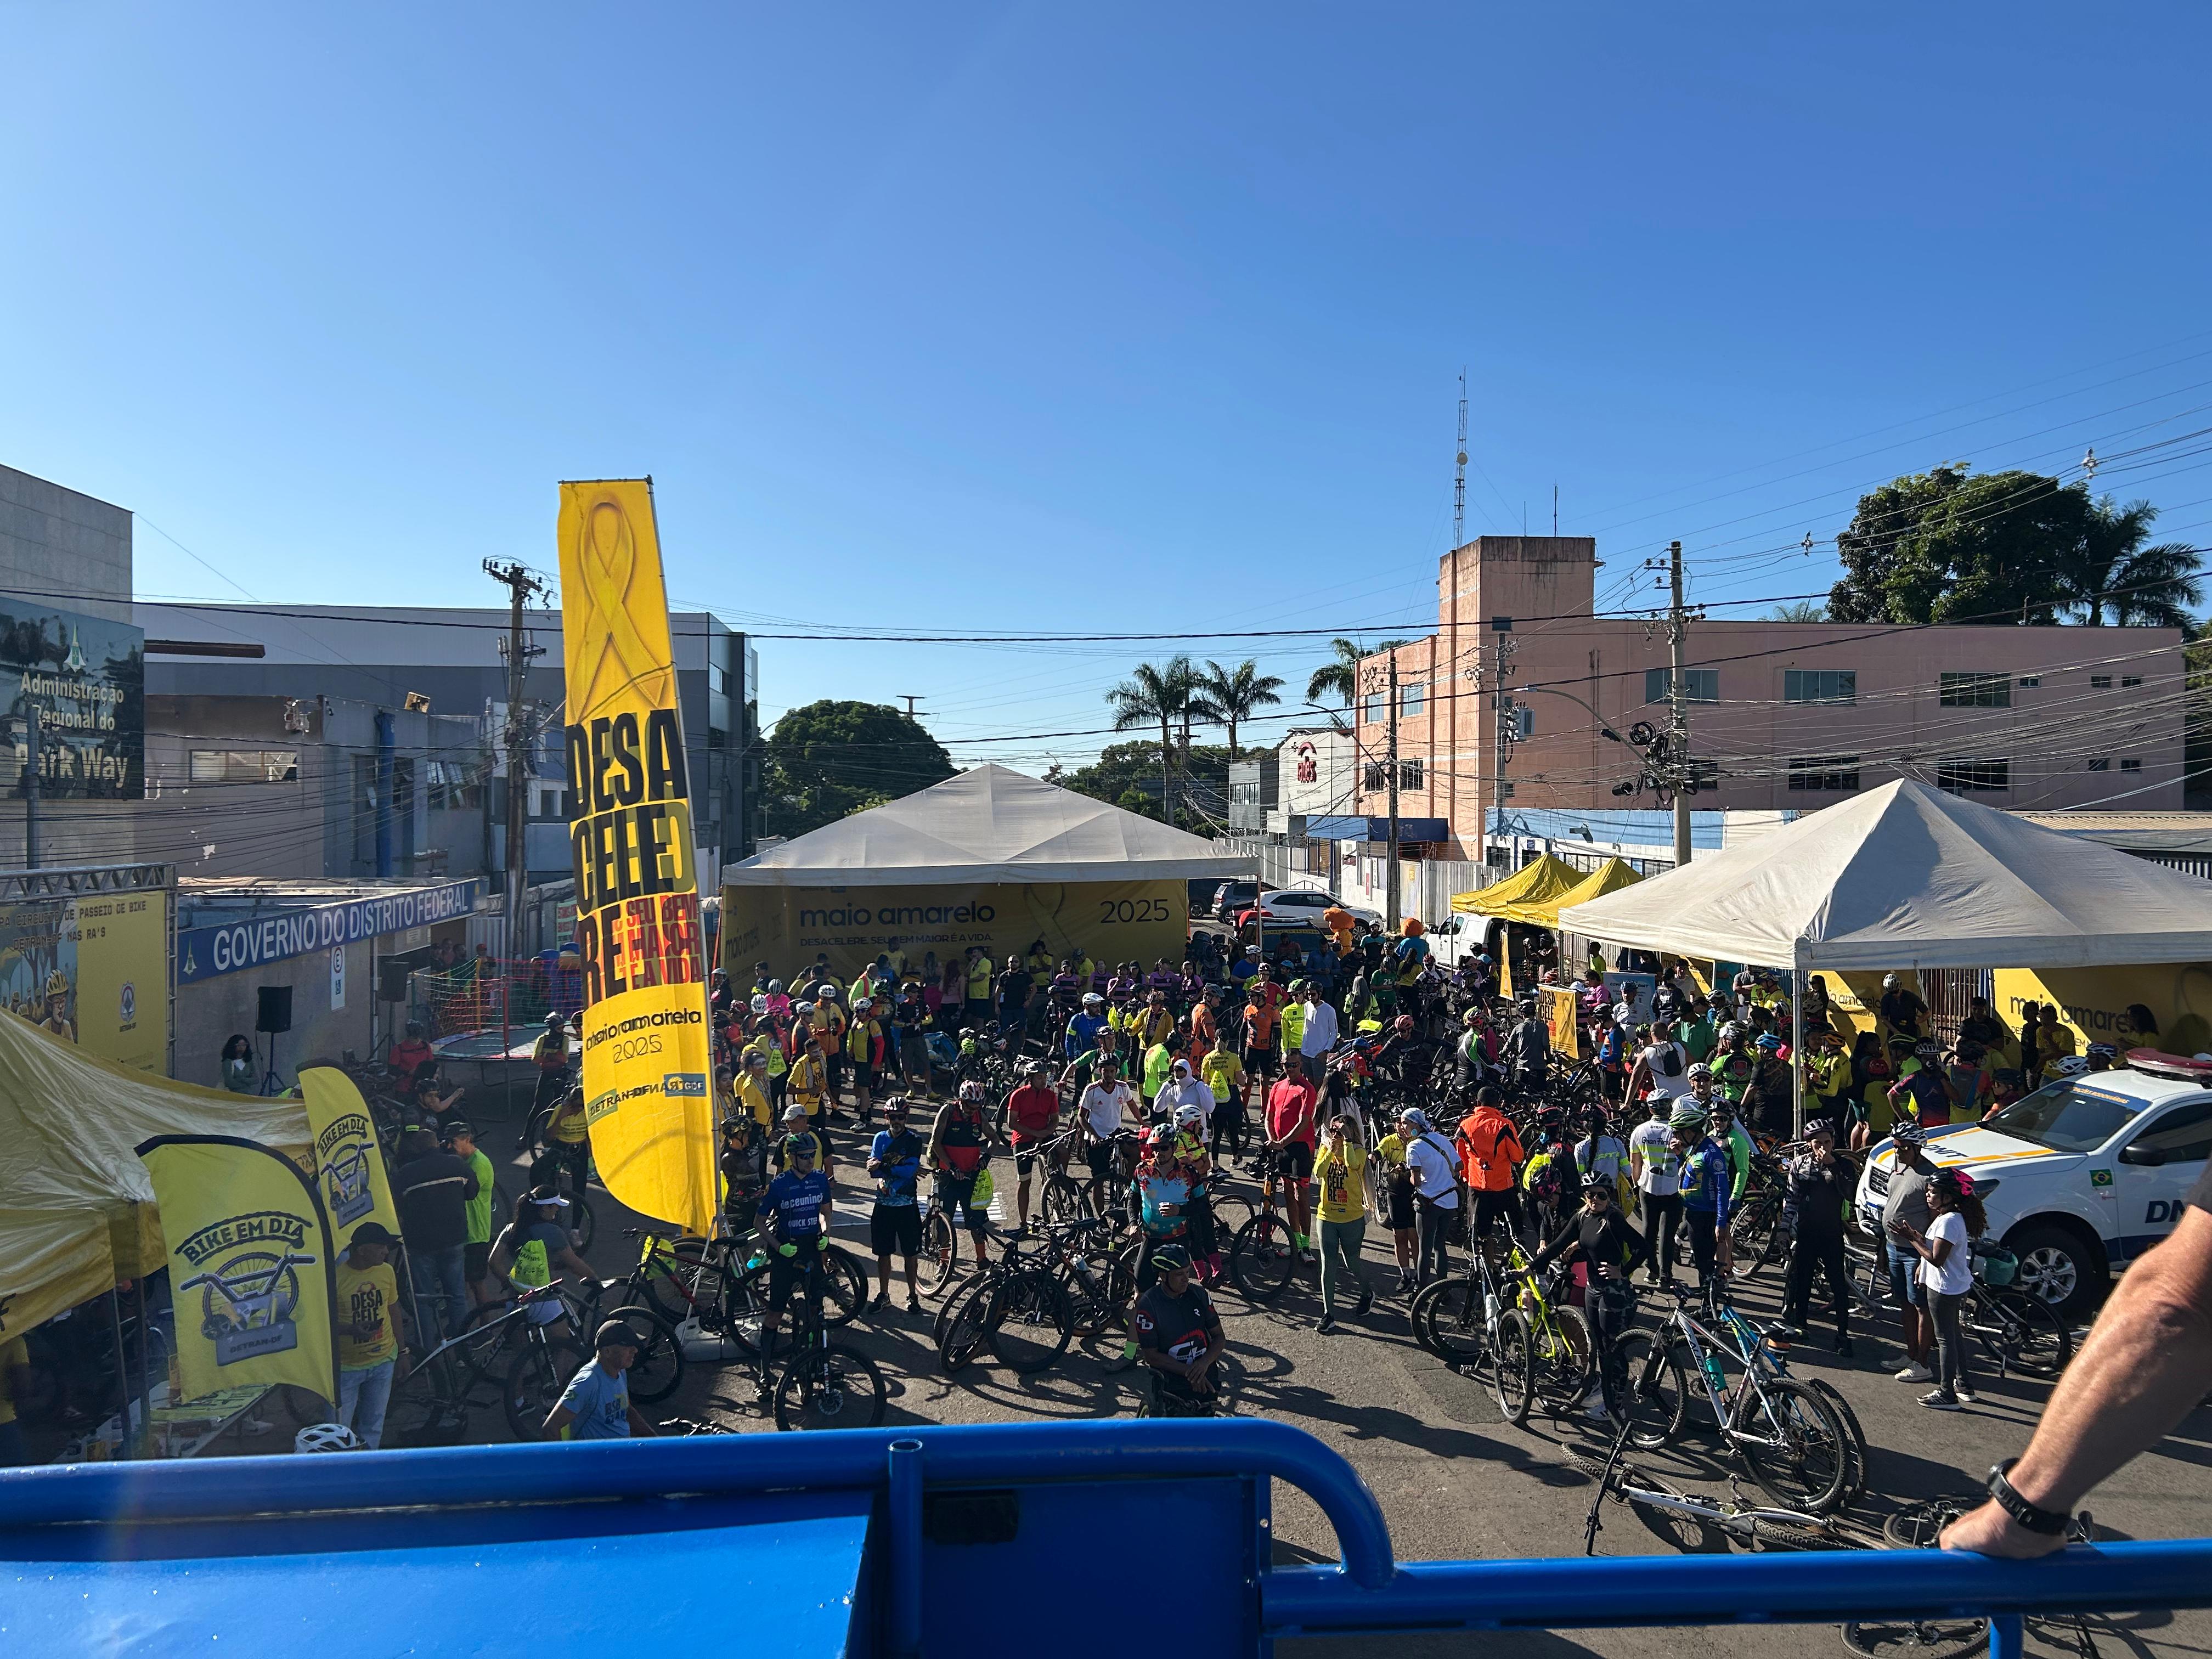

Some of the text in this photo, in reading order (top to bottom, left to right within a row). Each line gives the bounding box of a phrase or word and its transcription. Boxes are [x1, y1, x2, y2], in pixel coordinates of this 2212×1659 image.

[20, 672, 124, 706] Administração
[32, 704, 116, 731] Regional do
[15, 743, 128, 788] Park Way
[566, 708, 687, 822] DESA
[16, 911, 60, 927] CIRCUITO
[65, 909, 75, 921] DE
[79, 905, 112, 919] PASSEIO
[116, 903, 125, 914] DE
[129, 900, 146, 913] BIKE
[800, 900, 996, 927] maio amarelo
[1099, 898, 1170, 924] 2025
[13, 927, 106, 950] DETRAN-DF NAS RA'S
[213, 885, 468, 971] GOVERNO DO DISTRITO FEDERAL
[899, 935, 913, 944] EM
[916, 934, 949, 944] MAIOR
[951, 933, 958, 944] É
[959, 934, 967, 943] A
[1540, 989, 1556, 1007] DESA
[1540, 1005, 1554, 1022] CELE
[2061, 1004, 2129, 1034] amare
[612, 1034, 663, 1064] 2025
[320, 1118, 366, 1153] BIKE EM DIA
[1922, 1144, 1970, 1158] DNIT
[1327, 1161, 1349, 1178] DESA
[1327, 1174, 1345, 1190] CELE
[1328, 1188, 1338, 1202] RE
[788, 1218, 806, 1228] QUICK
[183, 1217, 304, 1262] BIKE EM DIA
[351, 1289, 383, 1311] DESA
[229, 1334, 283, 1353] DETRAN-DF
[1689, 1340, 1713, 1386] AUDAX
